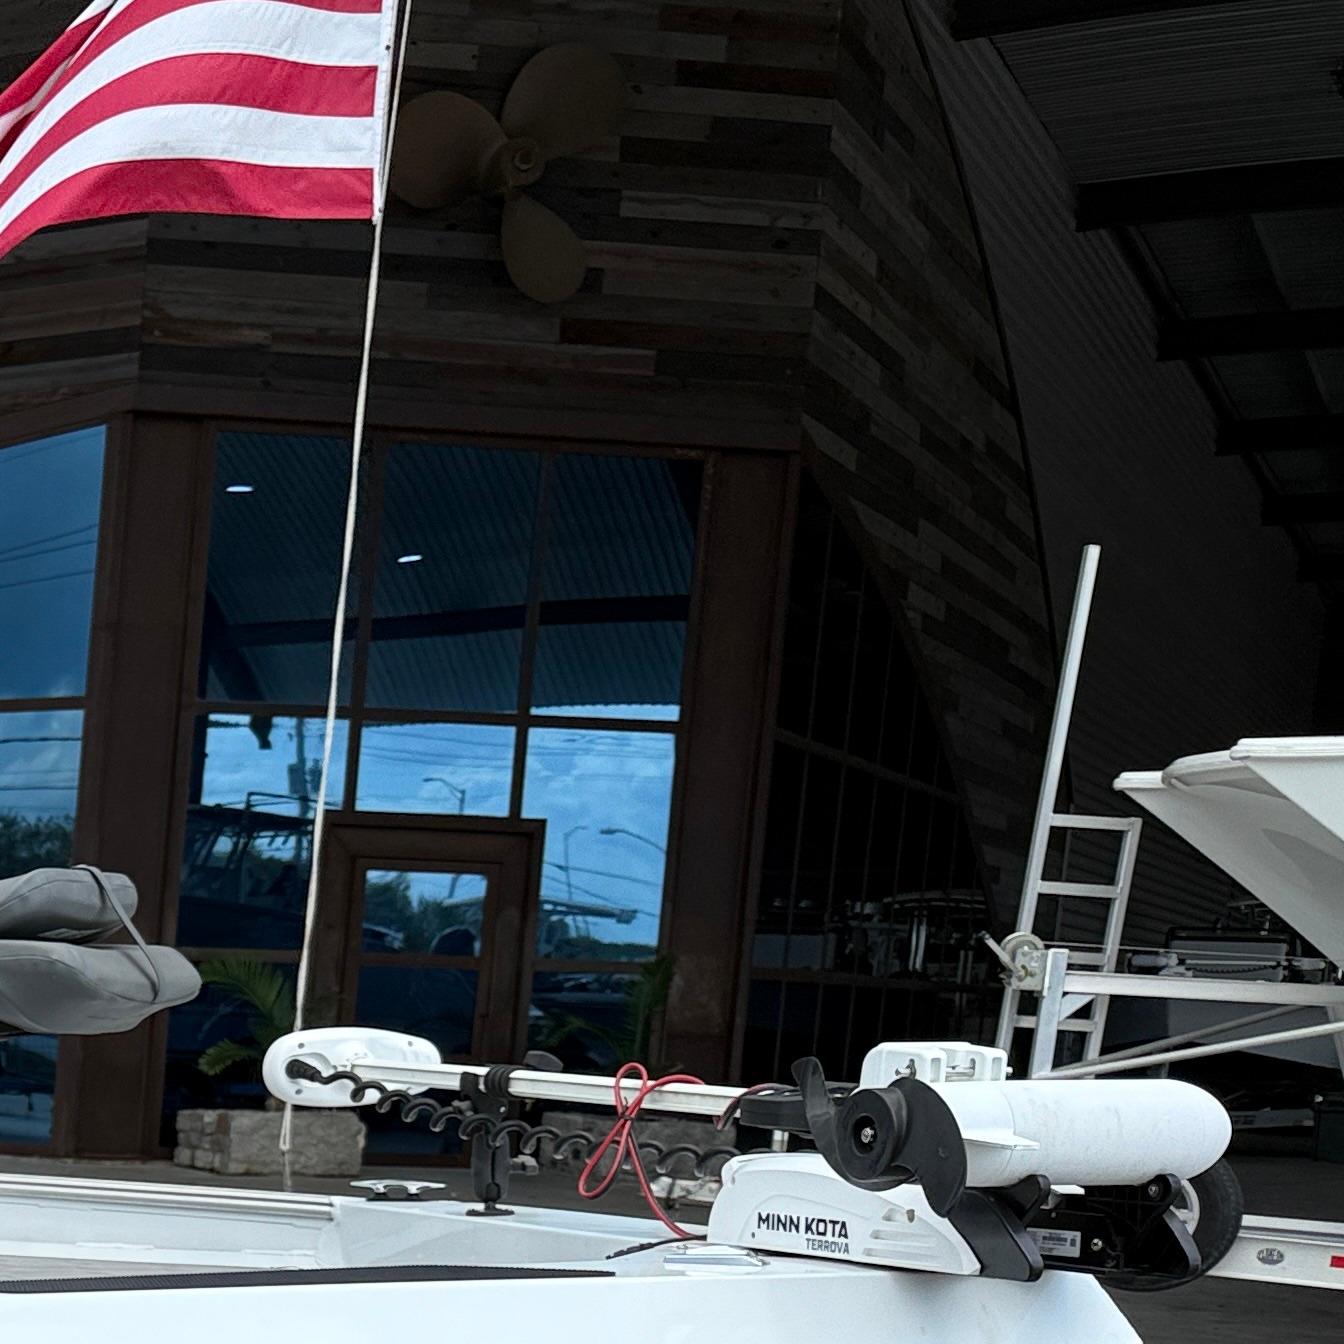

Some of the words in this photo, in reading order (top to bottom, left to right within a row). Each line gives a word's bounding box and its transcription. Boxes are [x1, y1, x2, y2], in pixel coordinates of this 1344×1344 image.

[757, 1212, 800, 1234] MINN
[804, 1216, 849, 1239] KOTA
[805, 1238, 850, 1255] TERROVA
